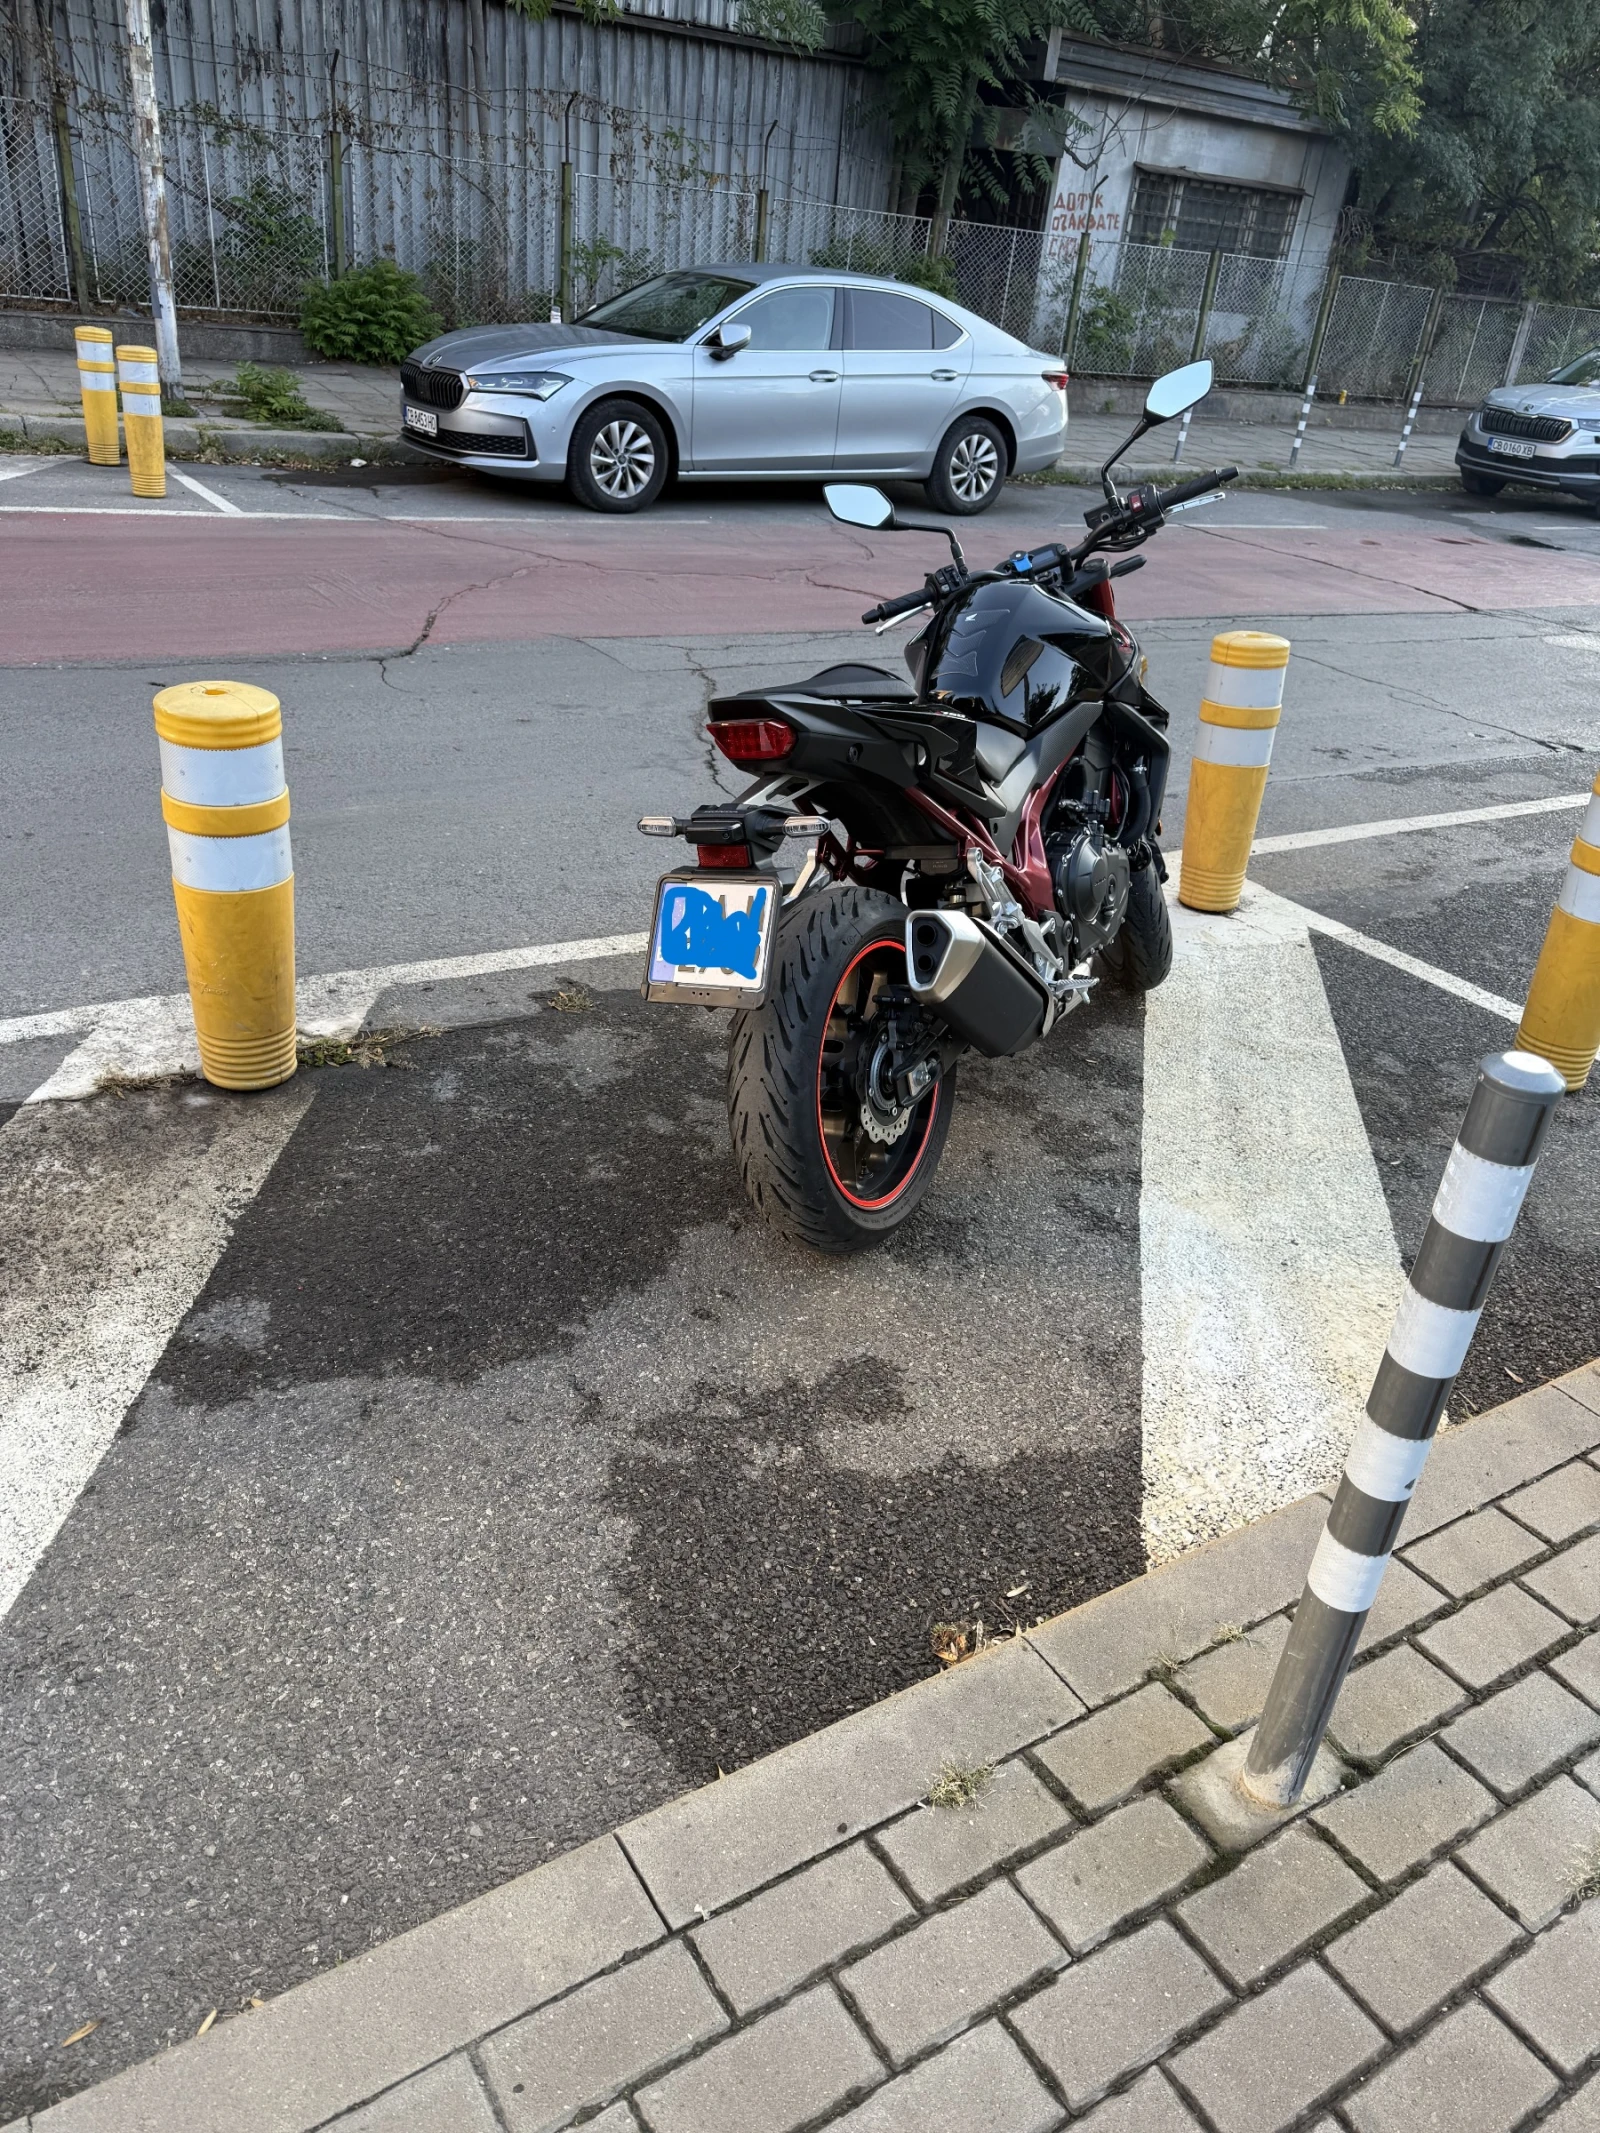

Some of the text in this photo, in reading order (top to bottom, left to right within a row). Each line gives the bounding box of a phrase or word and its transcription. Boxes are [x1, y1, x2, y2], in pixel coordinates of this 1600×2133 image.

[1492, 440, 1533, 455] CB 0160 XB
